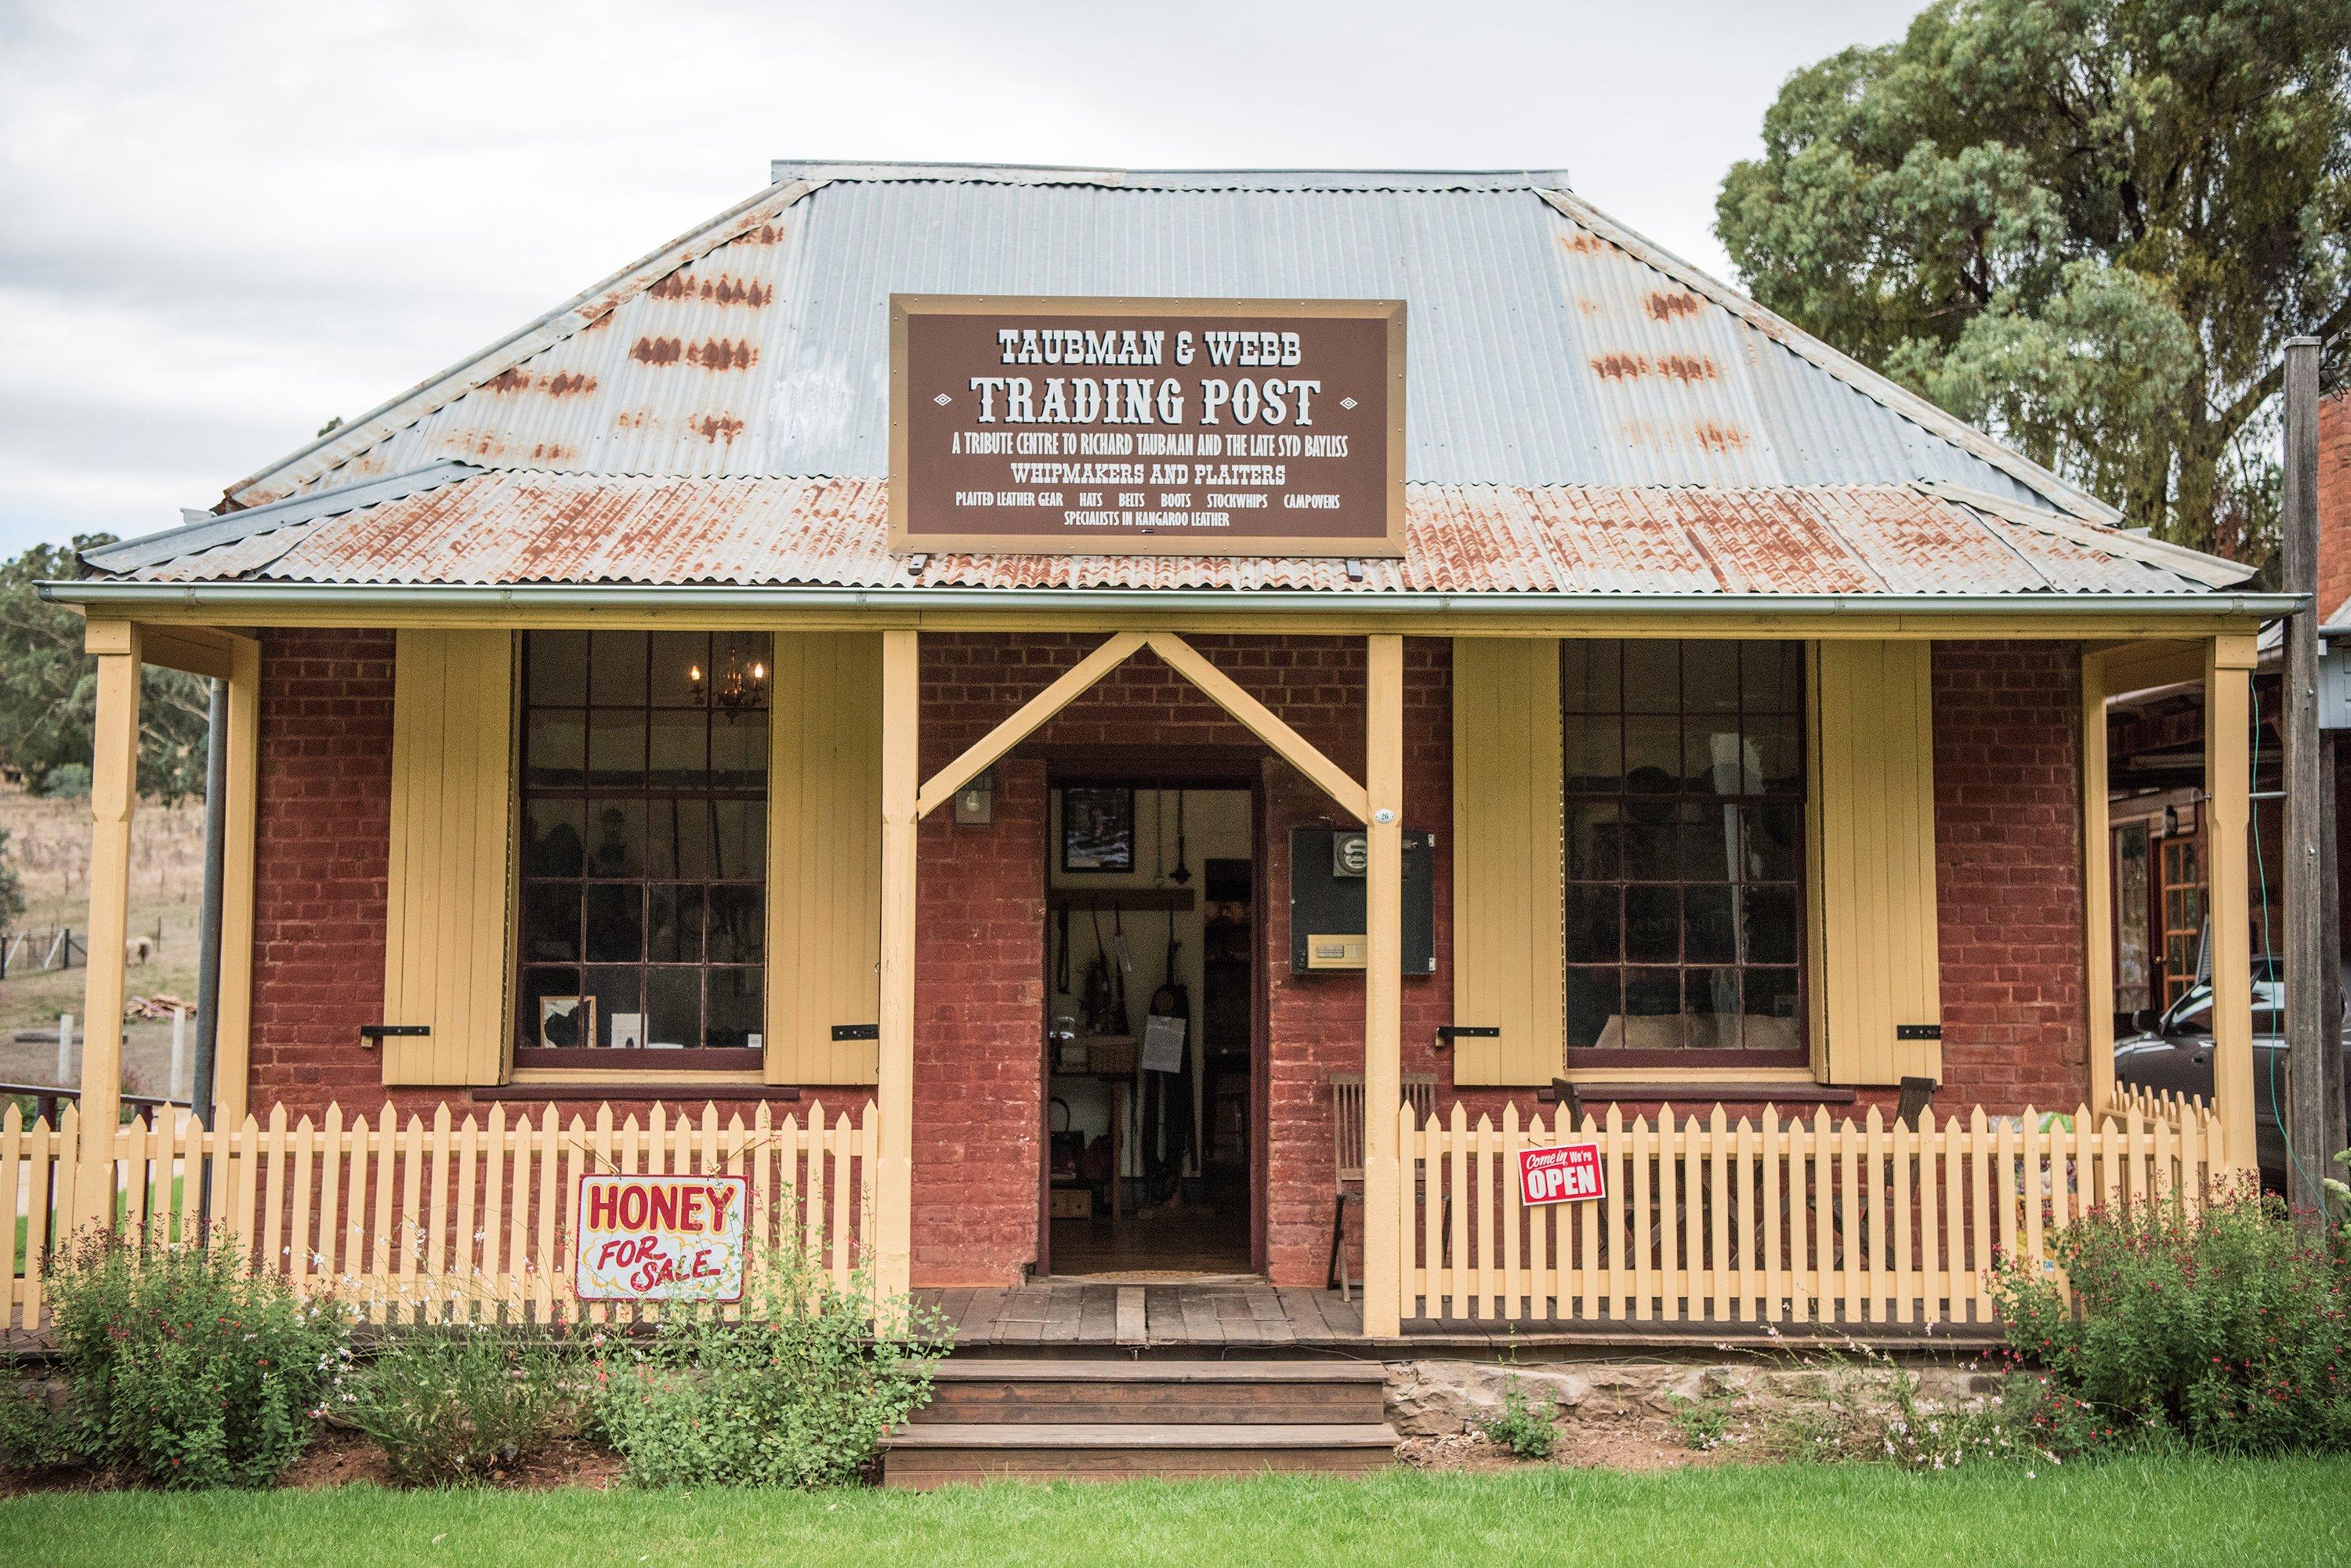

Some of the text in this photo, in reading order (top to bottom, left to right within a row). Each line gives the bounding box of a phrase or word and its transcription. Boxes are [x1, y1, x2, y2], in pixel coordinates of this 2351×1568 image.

[997, 329, 1302, 367] TAUBMAN & WEBB
[969, 377, 1321, 426] TRADING POST
[951, 432, 1348, 458] A TRIBUTE CENTRE TO RICHARD TAUBMAN AND THE LATE SYD BAYLISS
[1010, 462, 1286, 486] WHIPMAKERS AND PLAITERS
[955, 491, 994, 506] PLAITED
[996, 492, 1035, 506] LEATHER
[1038, 492, 1063, 507] GEAR
[1079, 492, 1103, 507] HATS
[1118, 493, 1145, 507] BELTS
[1161, 493, 1191, 508] BOOTS
[1207, 494, 1268, 509] STOCKWHIPS
[1063, 511, 1230, 527] SPECIALISTS IN KANGAROO LEATHER
[1380, 812, 1389, 820] 26
[1526, 1150, 1592, 1170] Come in We're
[1527, 1164, 1596, 1199] OPEN
[588, 1183, 737, 1235] HONEY
[596, 1235, 667, 1271] FOR
[630, 1249, 721, 1292] SALE
